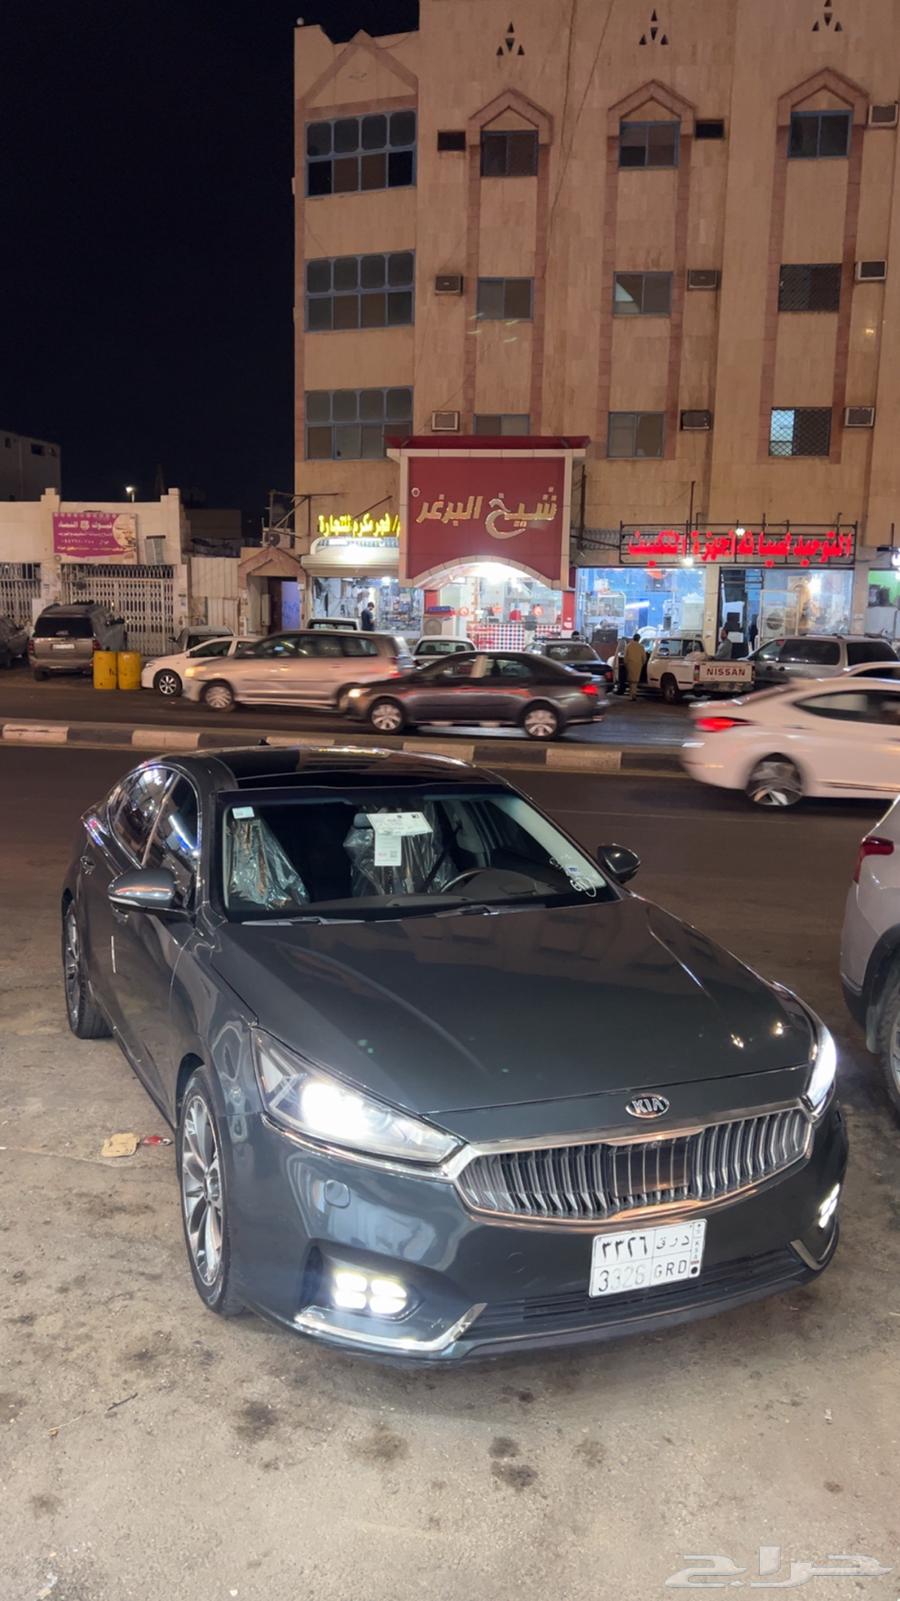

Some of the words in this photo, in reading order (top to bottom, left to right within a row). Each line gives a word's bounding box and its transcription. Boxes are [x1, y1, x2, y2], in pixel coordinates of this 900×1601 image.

[415, 493, 484, 526] البرغر
[485, 486, 558, 540] شيخ
[706, 668, 746, 676] NISSAN
[631, 1097, 665, 1114] KIA
[653, 1259, 688, 1279] GRD
